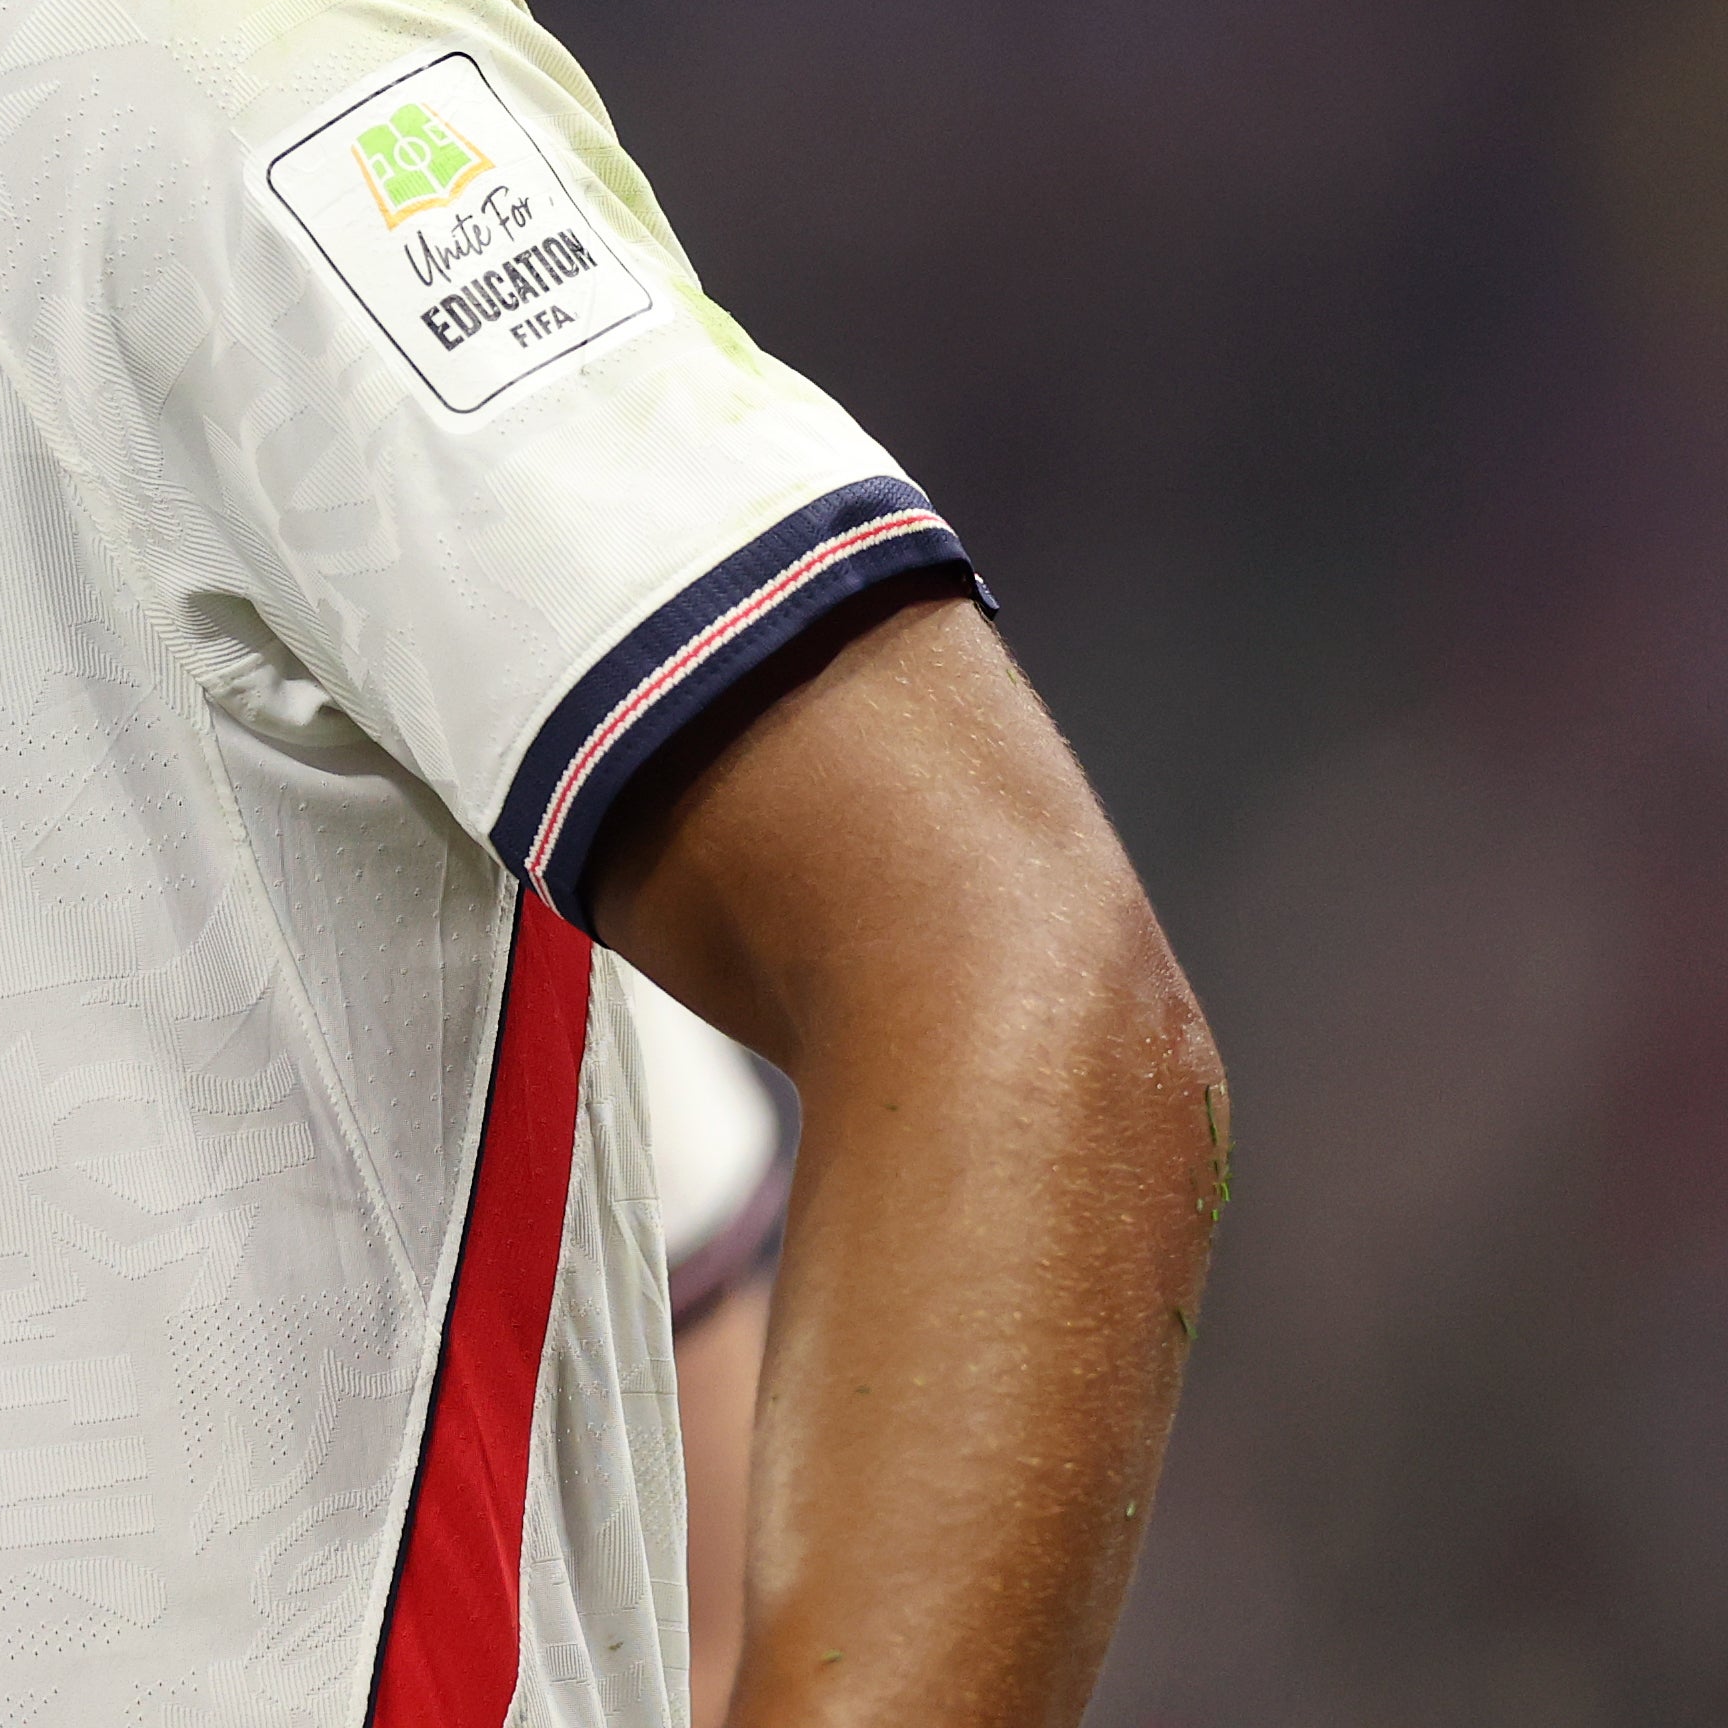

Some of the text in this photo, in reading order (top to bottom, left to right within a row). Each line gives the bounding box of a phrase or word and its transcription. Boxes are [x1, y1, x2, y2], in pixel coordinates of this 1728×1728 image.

[403, 185, 531, 287] Unite For
[419, 227, 598, 352] EDUCATION
[509, 304, 577, 349] FIFA
